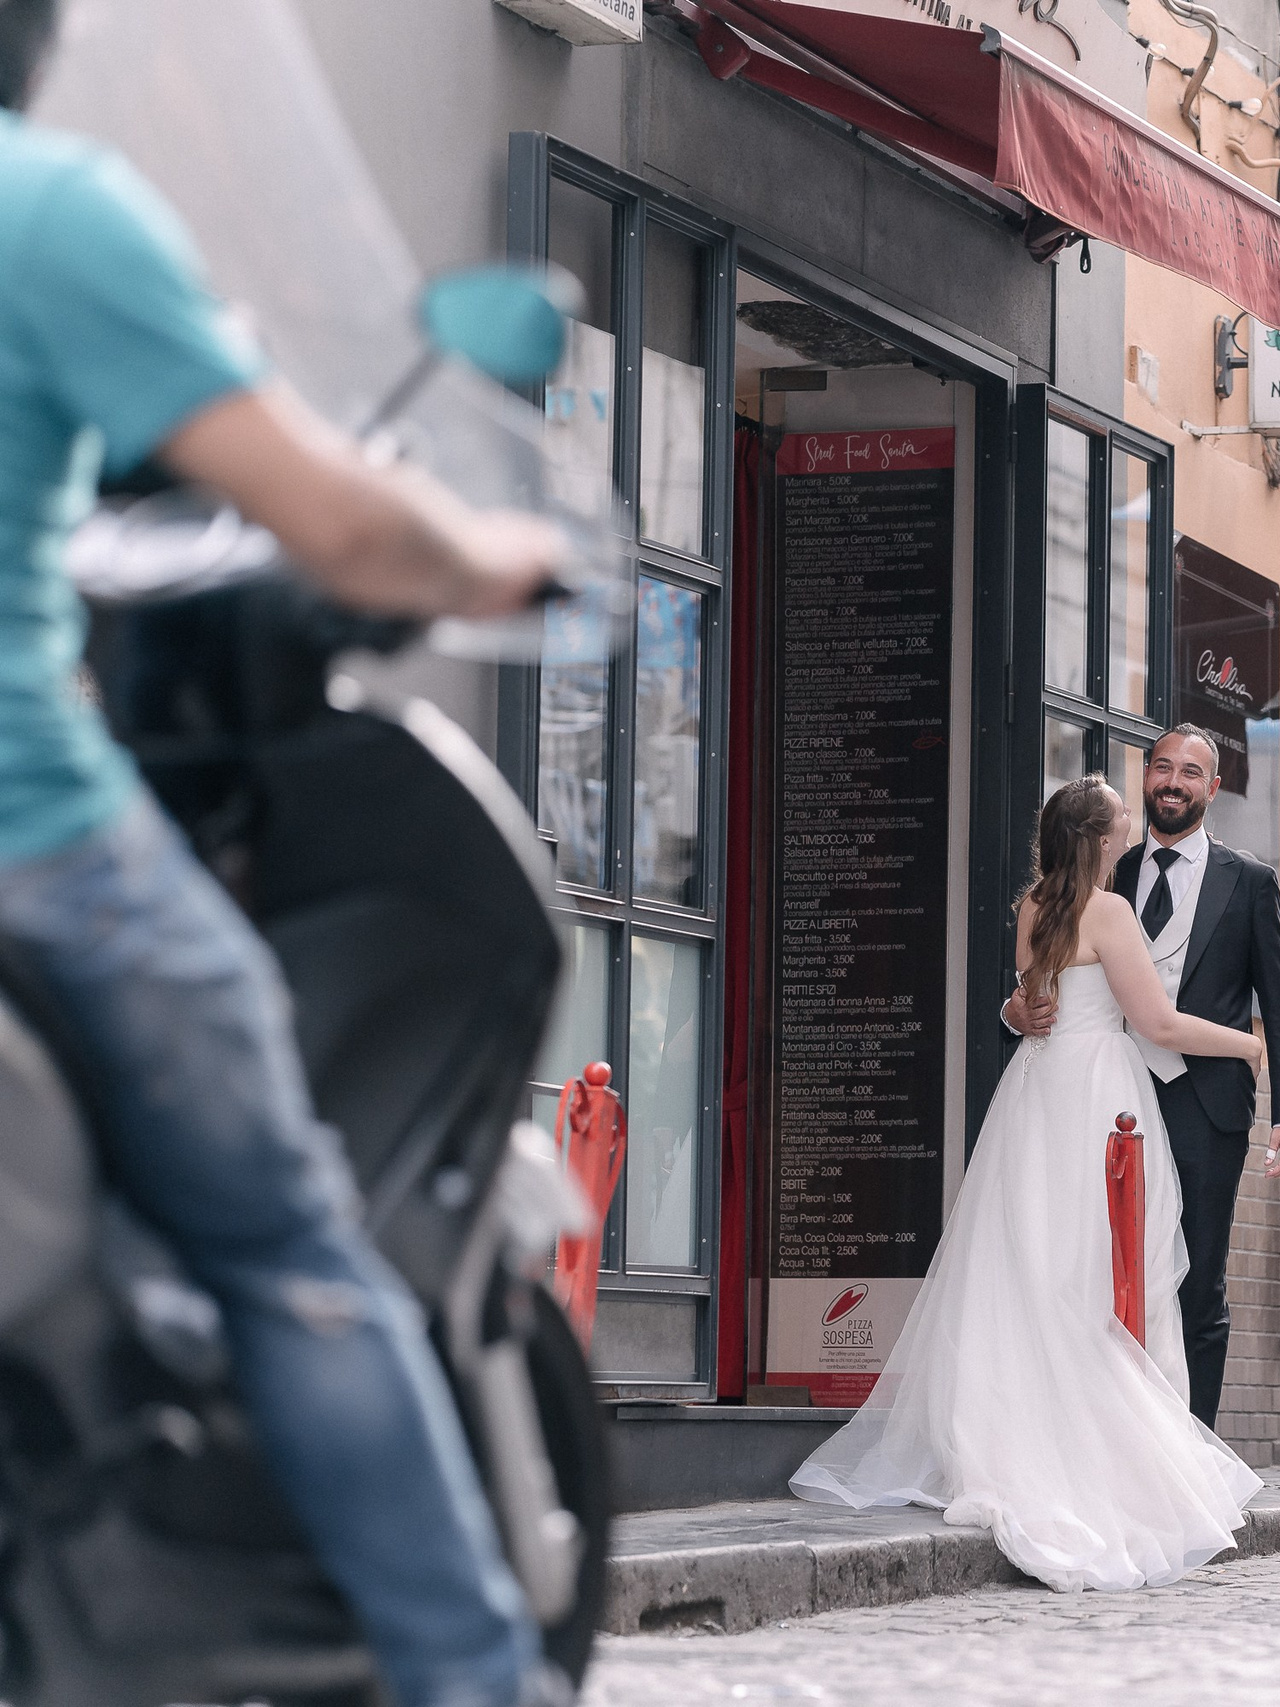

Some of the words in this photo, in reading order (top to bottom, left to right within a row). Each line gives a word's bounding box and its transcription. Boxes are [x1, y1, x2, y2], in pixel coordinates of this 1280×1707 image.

[806, 436, 835, 472] Street
[844, 434, 871, 469] Food
[879, 433, 928, 469] Sanità
[785, 478, 821, 487] Marinara
[785, 496, 829, 507] Margherita
[786, 516, 803, 526] San
[804, 516, 840, 525] Marzano
[785, 537, 833, 546] Fondazione
[851, 535, 886, 543] Gennaro
[785, 576, 835, 586] Pacchianella
[785, 608, 828, 617] Concettina
[785, 641, 822, 651] Salsiccia
[824, 642, 830, 650] e
[863, 639, 897, 649] vellutata
[785, 666, 810, 676] Carne
[811, 665, 845, 679] pizzaiola
[784, 738, 808, 748] PIZZE
[810, 737, 844, 747] RIPIENE
[784, 750, 814, 760] Ripieno
[816, 749, 847, 758] classico
[784, 774, 805, 783] Pizza
[806, 773, 823, 783] fritta
[784, 791, 814, 802] Ripieno
[833, 791, 861, 799] scarola
[784, 834, 849, 845] SALTIMBOCCA
[784, 847, 820, 857] Salsiccia
[830, 846, 858, 856] friarielli
[784, 872, 826, 881] Prosciutto
[836, 870, 867, 882] provola
[784, 920, 807, 930] PIZZE
[809, 920, 816, 929] A
[817, 919, 858, 929] LIBRETTA
[783, 935, 803, 944] Pizza
[805, 934, 821, 943] fritta
[829, 934, 851, 943] 3,50€
[783, 956, 826, 967] Margherita
[834, 955, 855, 964] 3,50€
[783, 969, 818, 978] Marinara
[825, 968, 847, 978] 3,50€
[783, 985, 807, 995] FRITTI
[809, 985, 815, 995] E
[816, 985, 836, 995] SFIZI
[783, 998, 826, 1007] Montanara
[828, 997, 835, 1006] di
[837, 998, 862, 1006] nonna
[864, 997, 885, 1005] Anna
[893, 996, 913, 1005] 3,50€
[782, 1024, 826, 1033] Montanara
[828, 1023, 835, 1032] di
[864, 1022, 894, 1032] Antonio
[901, 1022, 922, 1032] 3,50€
[782, 1042, 826, 1051] Montanara
[827, 1041, 834, 1050] di
[836, 1041, 852, 1050] Ciro
[860, 1041, 881, 1051] 3,50€
[782, 1061, 815, 1070] Tracchia
[817, 1061, 832, 1069] and
[834, 1060, 852, 1069] Pork
[860, 1060, 881, 1070] 4,00€
[782, 1086, 809, 1096] Panino
[852, 1086, 873, 1095] 4,00€
[782, 1111, 815, 1120] Frittatina
[816, 1111, 847, 1120] classica
[854, 1110, 875, 1120] 2,00€
[781, 1135, 814, 1144] Frittatina
[816, 1136, 854, 1146] genovese
[861, 1134, 882, 1144] 2,00€
[781, 1166, 814, 1176] Crocchè
[821, 1167, 842, 1177] 2,00€
[781, 1180, 807, 1189] BIBITE
[780, 1193, 798, 1203] Birra
[800, 1193, 825, 1203] Peroni
[833, 1194, 852, 1203] 1,50€
[780, 1214, 798, 1223] Birra
[800, 1214, 825, 1223] Peroni
[832, 1214, 854, 1223] 2,00€
[780, 1233, 802, 1243] Fanta,
[804, 1233, 825, 1243] Coca
[827, 1233, 845, 1243] Cola
[847, 1234, 864, 1243] zero,
[866, 1233, 888, 1243] Sprite
[895, 1233, 916, 1243] 2,00€
[779, 1246, 800, 1256] Coca
[801, 1246, 819, 1255] Cola
[836, 1246, 858, 1256] 2,50€
[779, 1259, 804, 1268] Acqua
[812, 1258, 831, 1268] 1,50€
[848, 1320, 873, 1329] PIZZA
[822, 1330, 873, 1345] SOSPESA
